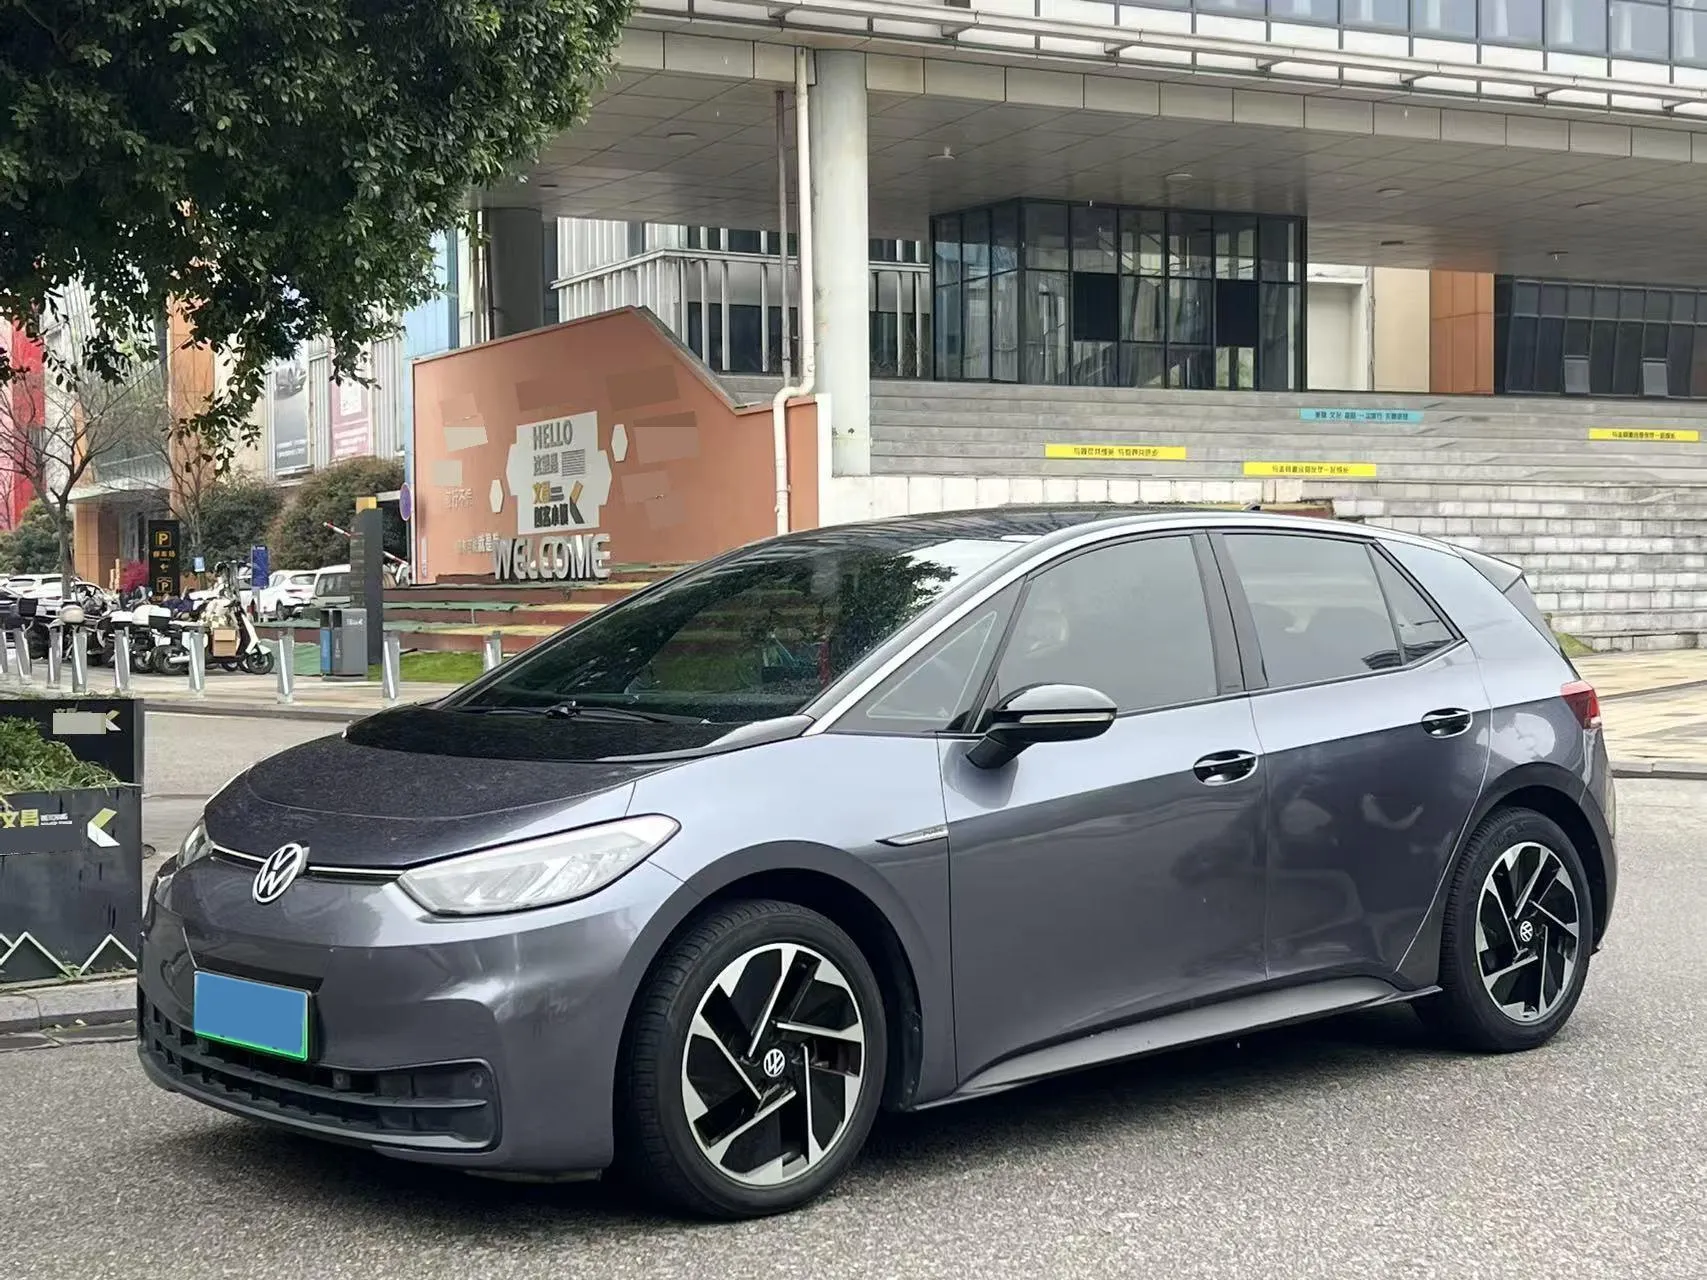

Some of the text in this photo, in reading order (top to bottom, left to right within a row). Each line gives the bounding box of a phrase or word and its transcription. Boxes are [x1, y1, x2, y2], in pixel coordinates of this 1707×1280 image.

[532, 419, 573, 450] HELLO
[158, 533, 169, 545] P
[492, 533, 611, 580] WELCOME
